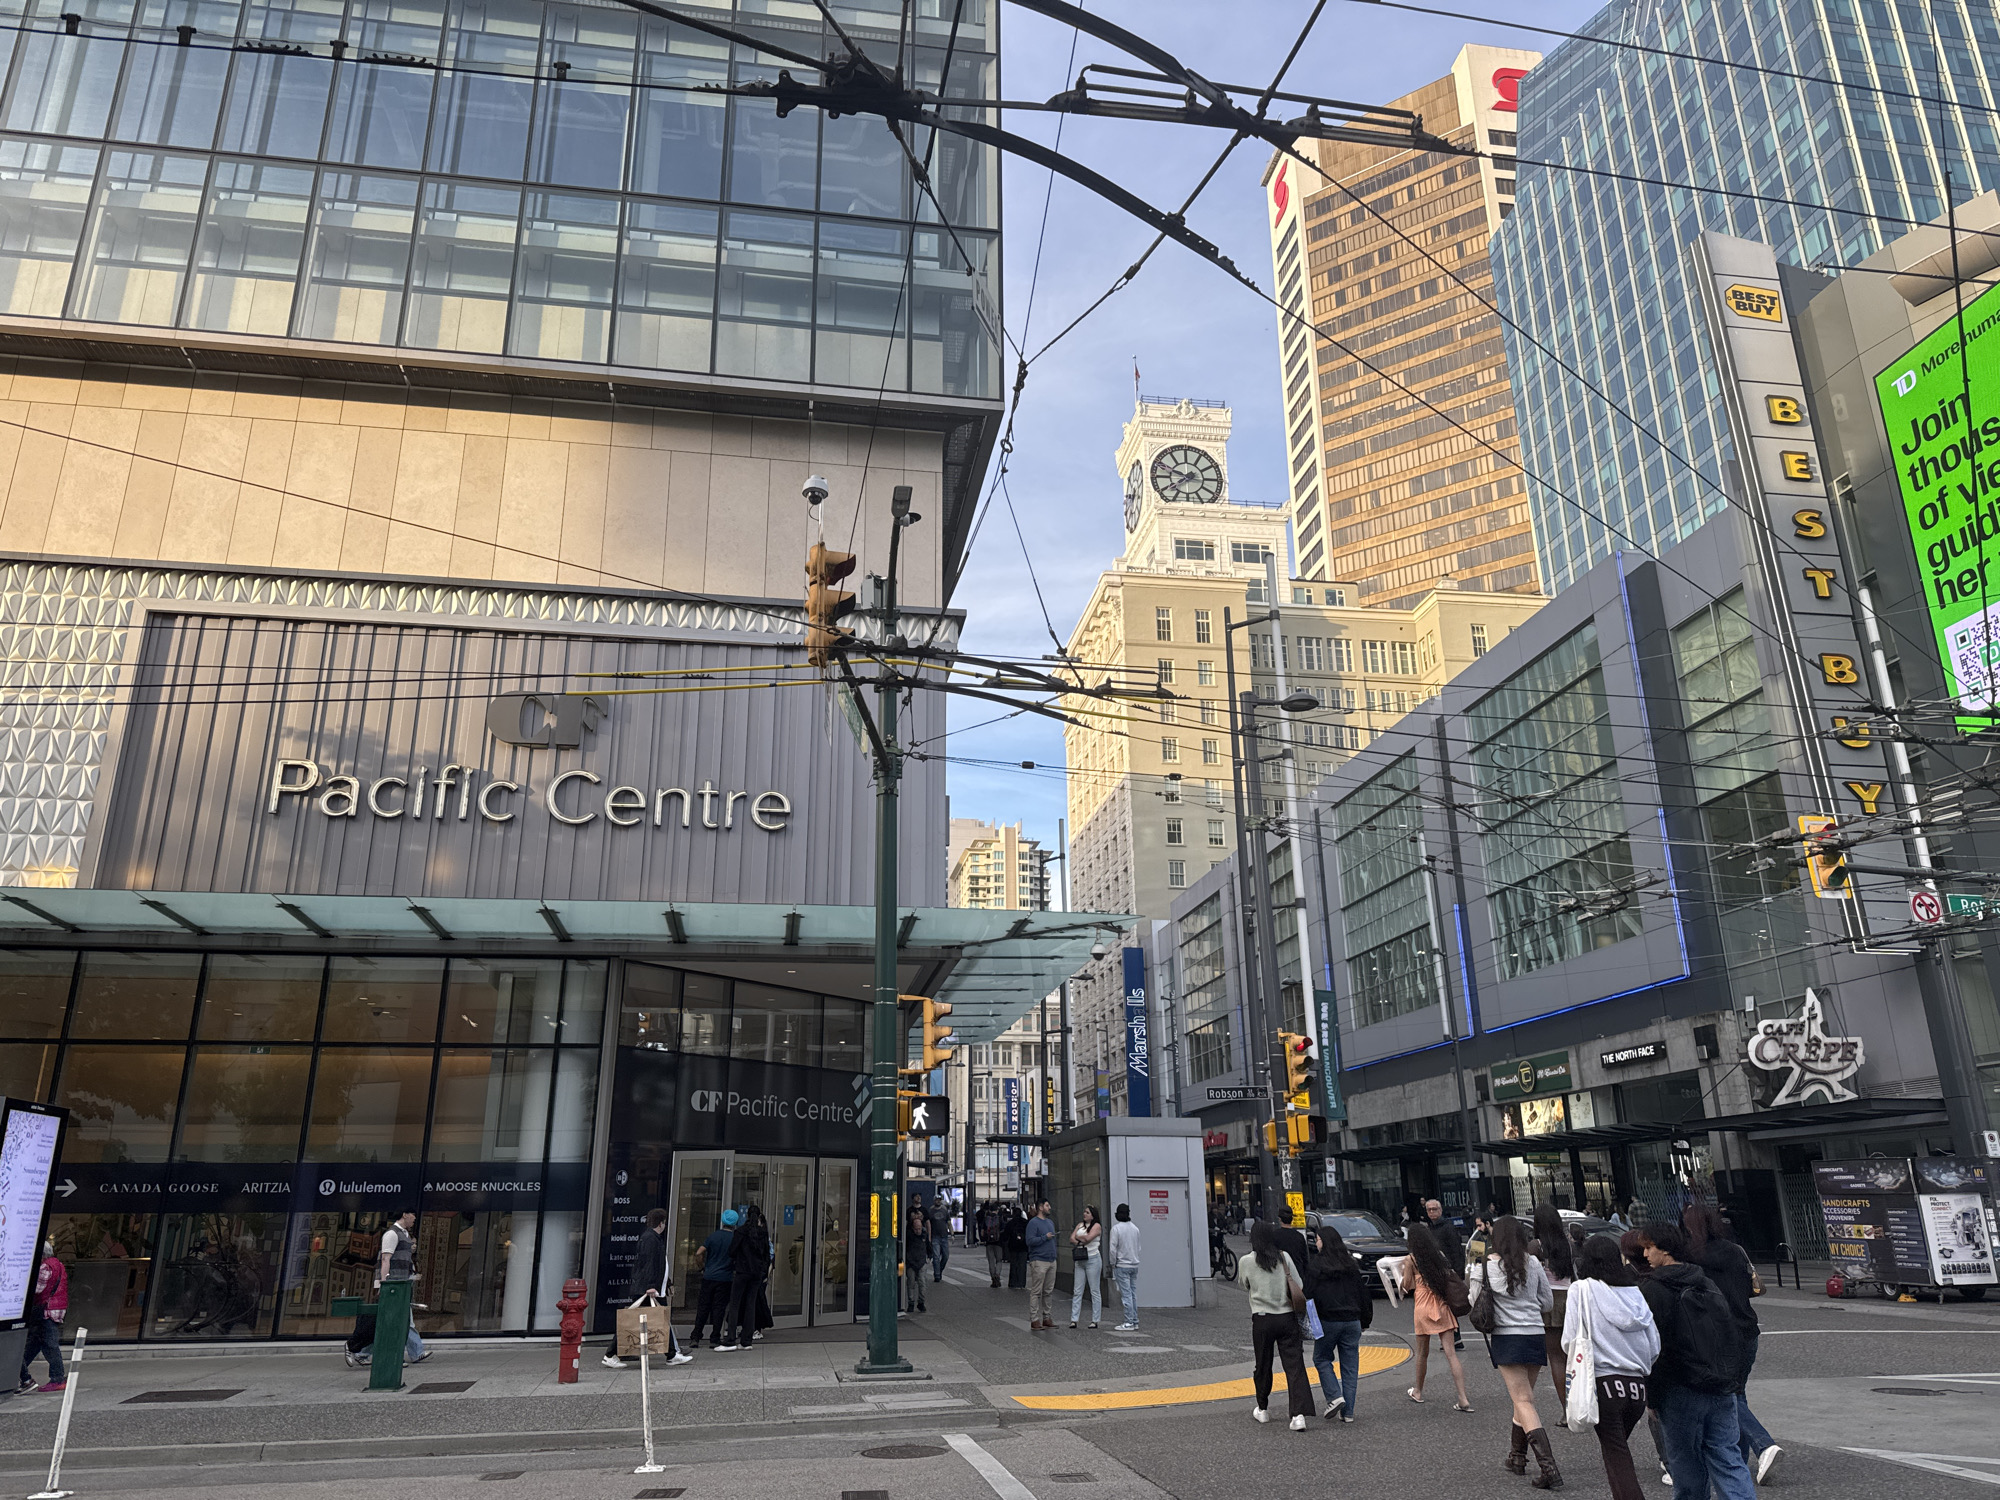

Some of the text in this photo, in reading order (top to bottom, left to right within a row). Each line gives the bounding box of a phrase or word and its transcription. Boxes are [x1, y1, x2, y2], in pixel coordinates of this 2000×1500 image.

[1731, 289, 1778, 306] BEST
[1735, 300, 1775, 316] BUY
[1890, 369, 1917, 398] TD
[1920, 340, 1961, 377] More
[1901, 392, 1969, 456] Join
[1918, 484, 1949, 531] of
[1933, 556, 1991, 610] her
[1764, 394, 1887, 816] BEST BUY
[486, 690, 609, 749] CF
[267, 757, 792, 832] Pacific Centre
[1126, 987, 1149, 1078] Marshalls
[1601, 1045, 1655, 1065] THE NORTH FACE
[1755, 1035, 1859, 1064] CRÊPE
[1322, 1047, 1337, 1109] VANCOUVER
[1209, 1088, 1244, 1099] Robson
[690, 1089, 854, 1124] CF Pacific Centre
[99, 1183, 219, 1194] CANADA GOOSE
[241, 1182, 291, 1194] ARITZIA
[339, 1181, 402, 1193] lululemon
[435, 1181, 541, 1192] MOOSE KNUCKLES
[613, 1197, 631, 1205] BOSS
[1821, 1199, 1871, 1208] HANDICRAFTS
[612, 1215, 639, 1223] LACOSTE
[1823, 1207, 1861, 1215] ACCESSORIES
[609, 1252, 639, 1263] kate spad
[1829, 1243, 1866, 1257] MY CHOICE
